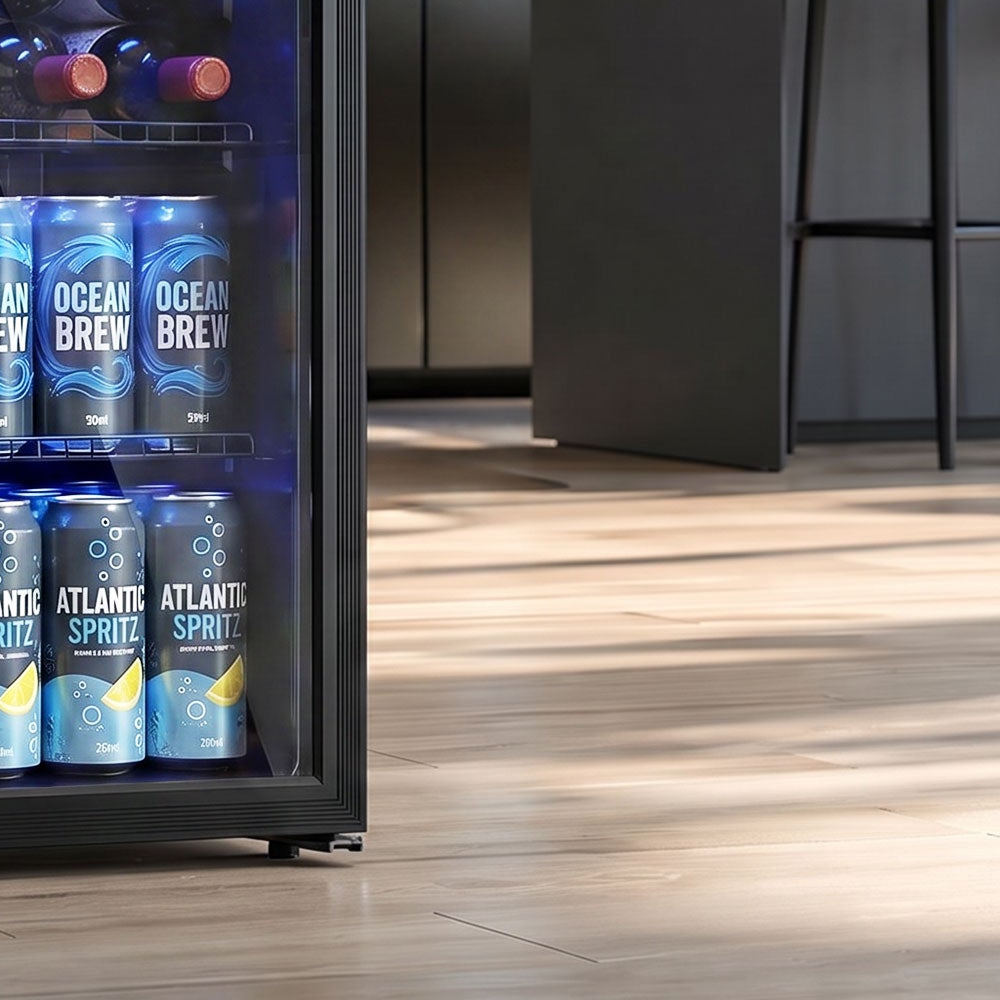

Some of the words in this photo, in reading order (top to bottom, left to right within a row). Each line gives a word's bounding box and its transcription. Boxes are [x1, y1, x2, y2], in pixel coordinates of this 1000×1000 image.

[54, 281, 131, 313] OCEAN
[155, 280, 229, 311] OCEAN
[55, 314, 131, 351] BREW
[157, 313, 230, 350] BREW
[56, 584, 145, 615] ATLANTIC
[160, 581, 247, 611] ATLANTIC
[68, 615, 139, 645] SPRITZ
[173, 612, 242, 640] SPRITZ
